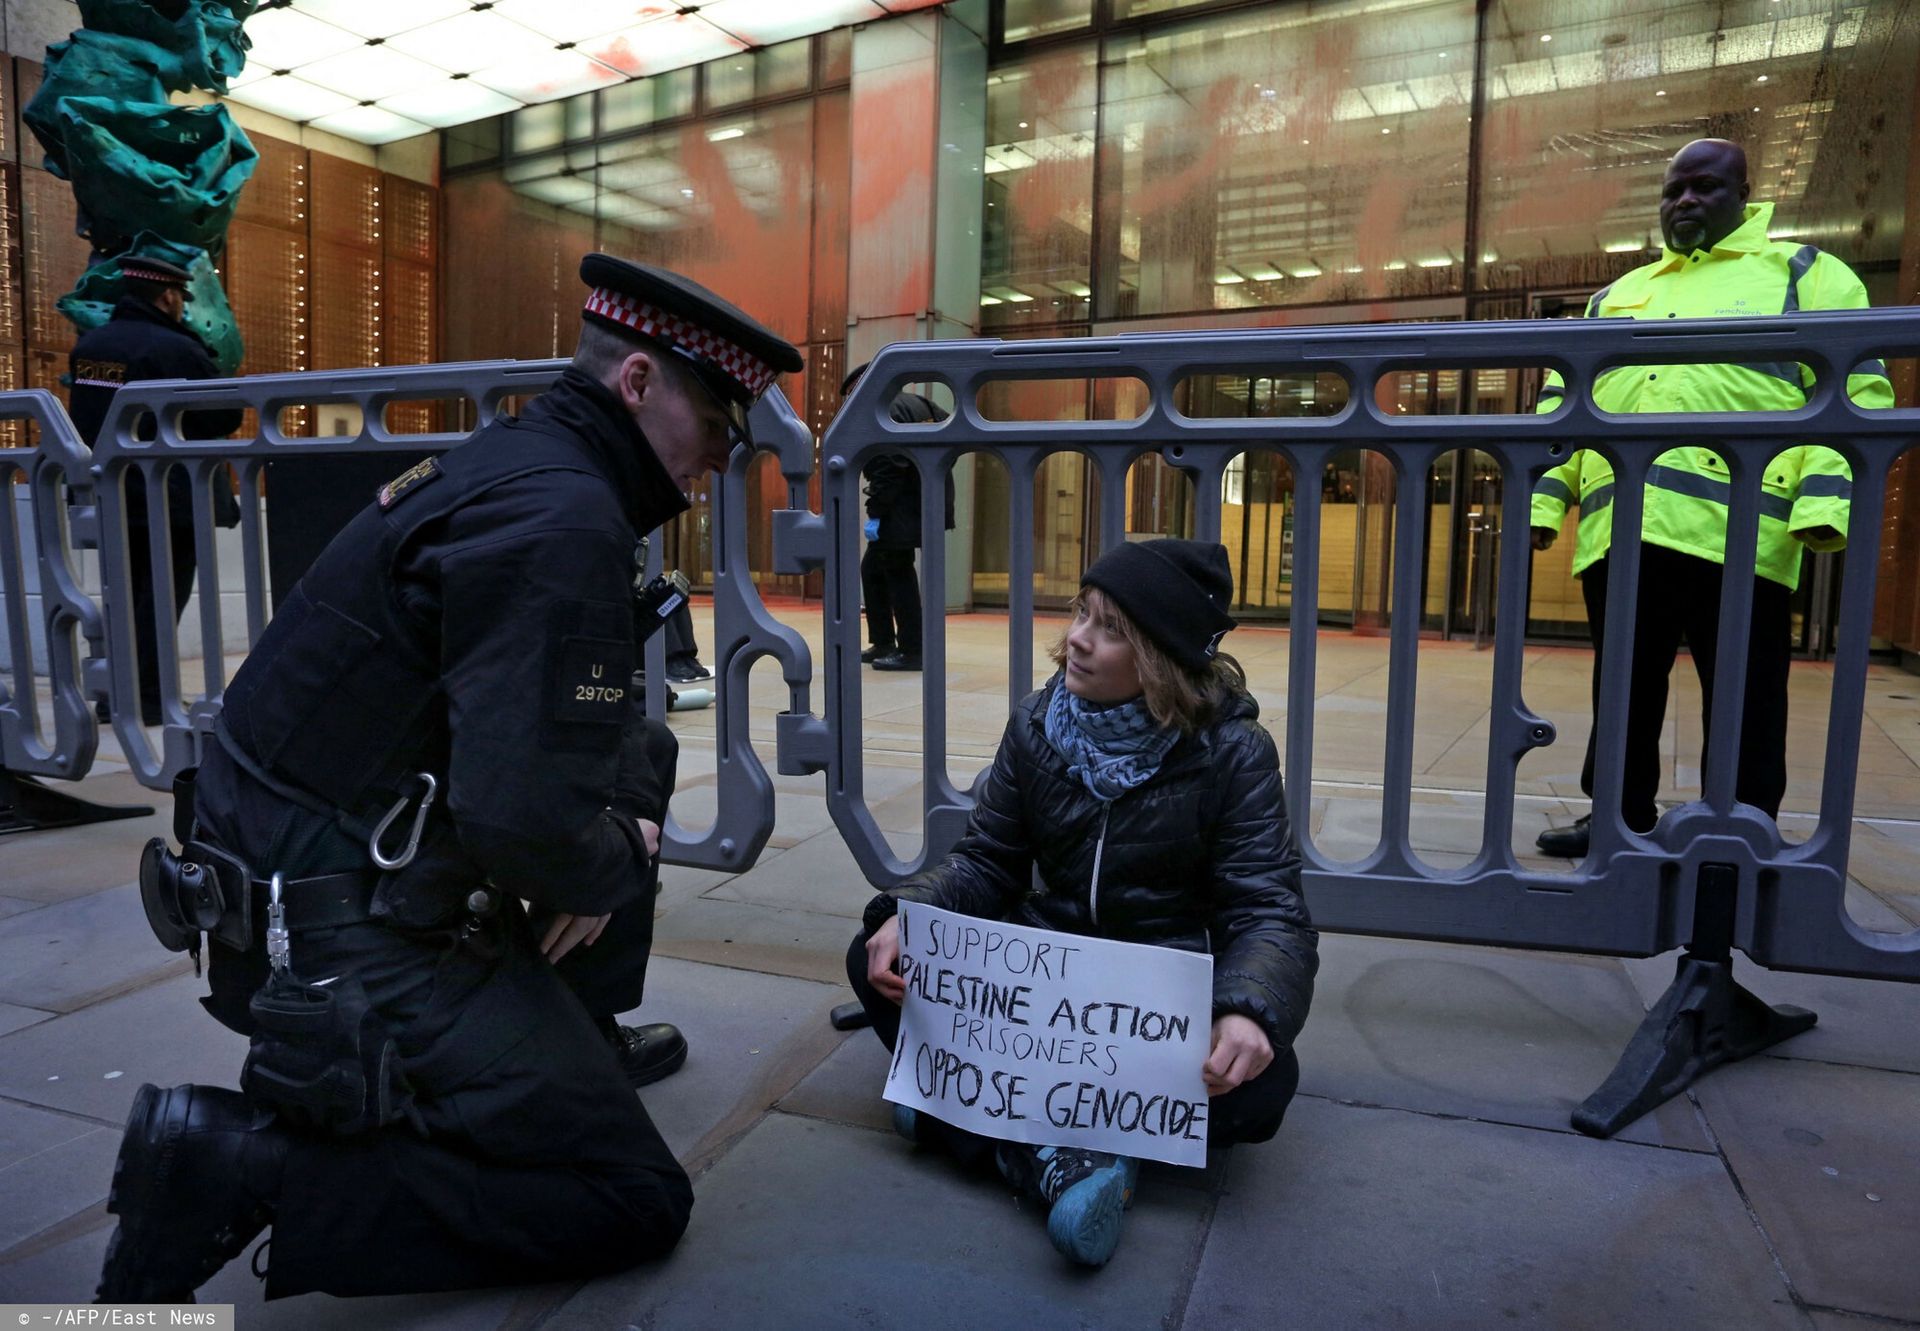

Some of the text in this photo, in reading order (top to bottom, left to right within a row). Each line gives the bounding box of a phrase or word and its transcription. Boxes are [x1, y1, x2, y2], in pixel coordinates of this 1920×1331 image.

[76, 364, 124, 383] POLICE
[575, 685, 624, 703] 297CP
[591, 663, 603, 679] U
[903, 908, 1081, 981] I SUPPORT
[900, 954, 1191, 1043] PALESTINE ACTION
[951, 1012, 1121, 1077] PRISONERS
[915, 1042, 1029, 1121] OPPOSE
[1044, 1081, 1208, 1142] GENOCIDE
